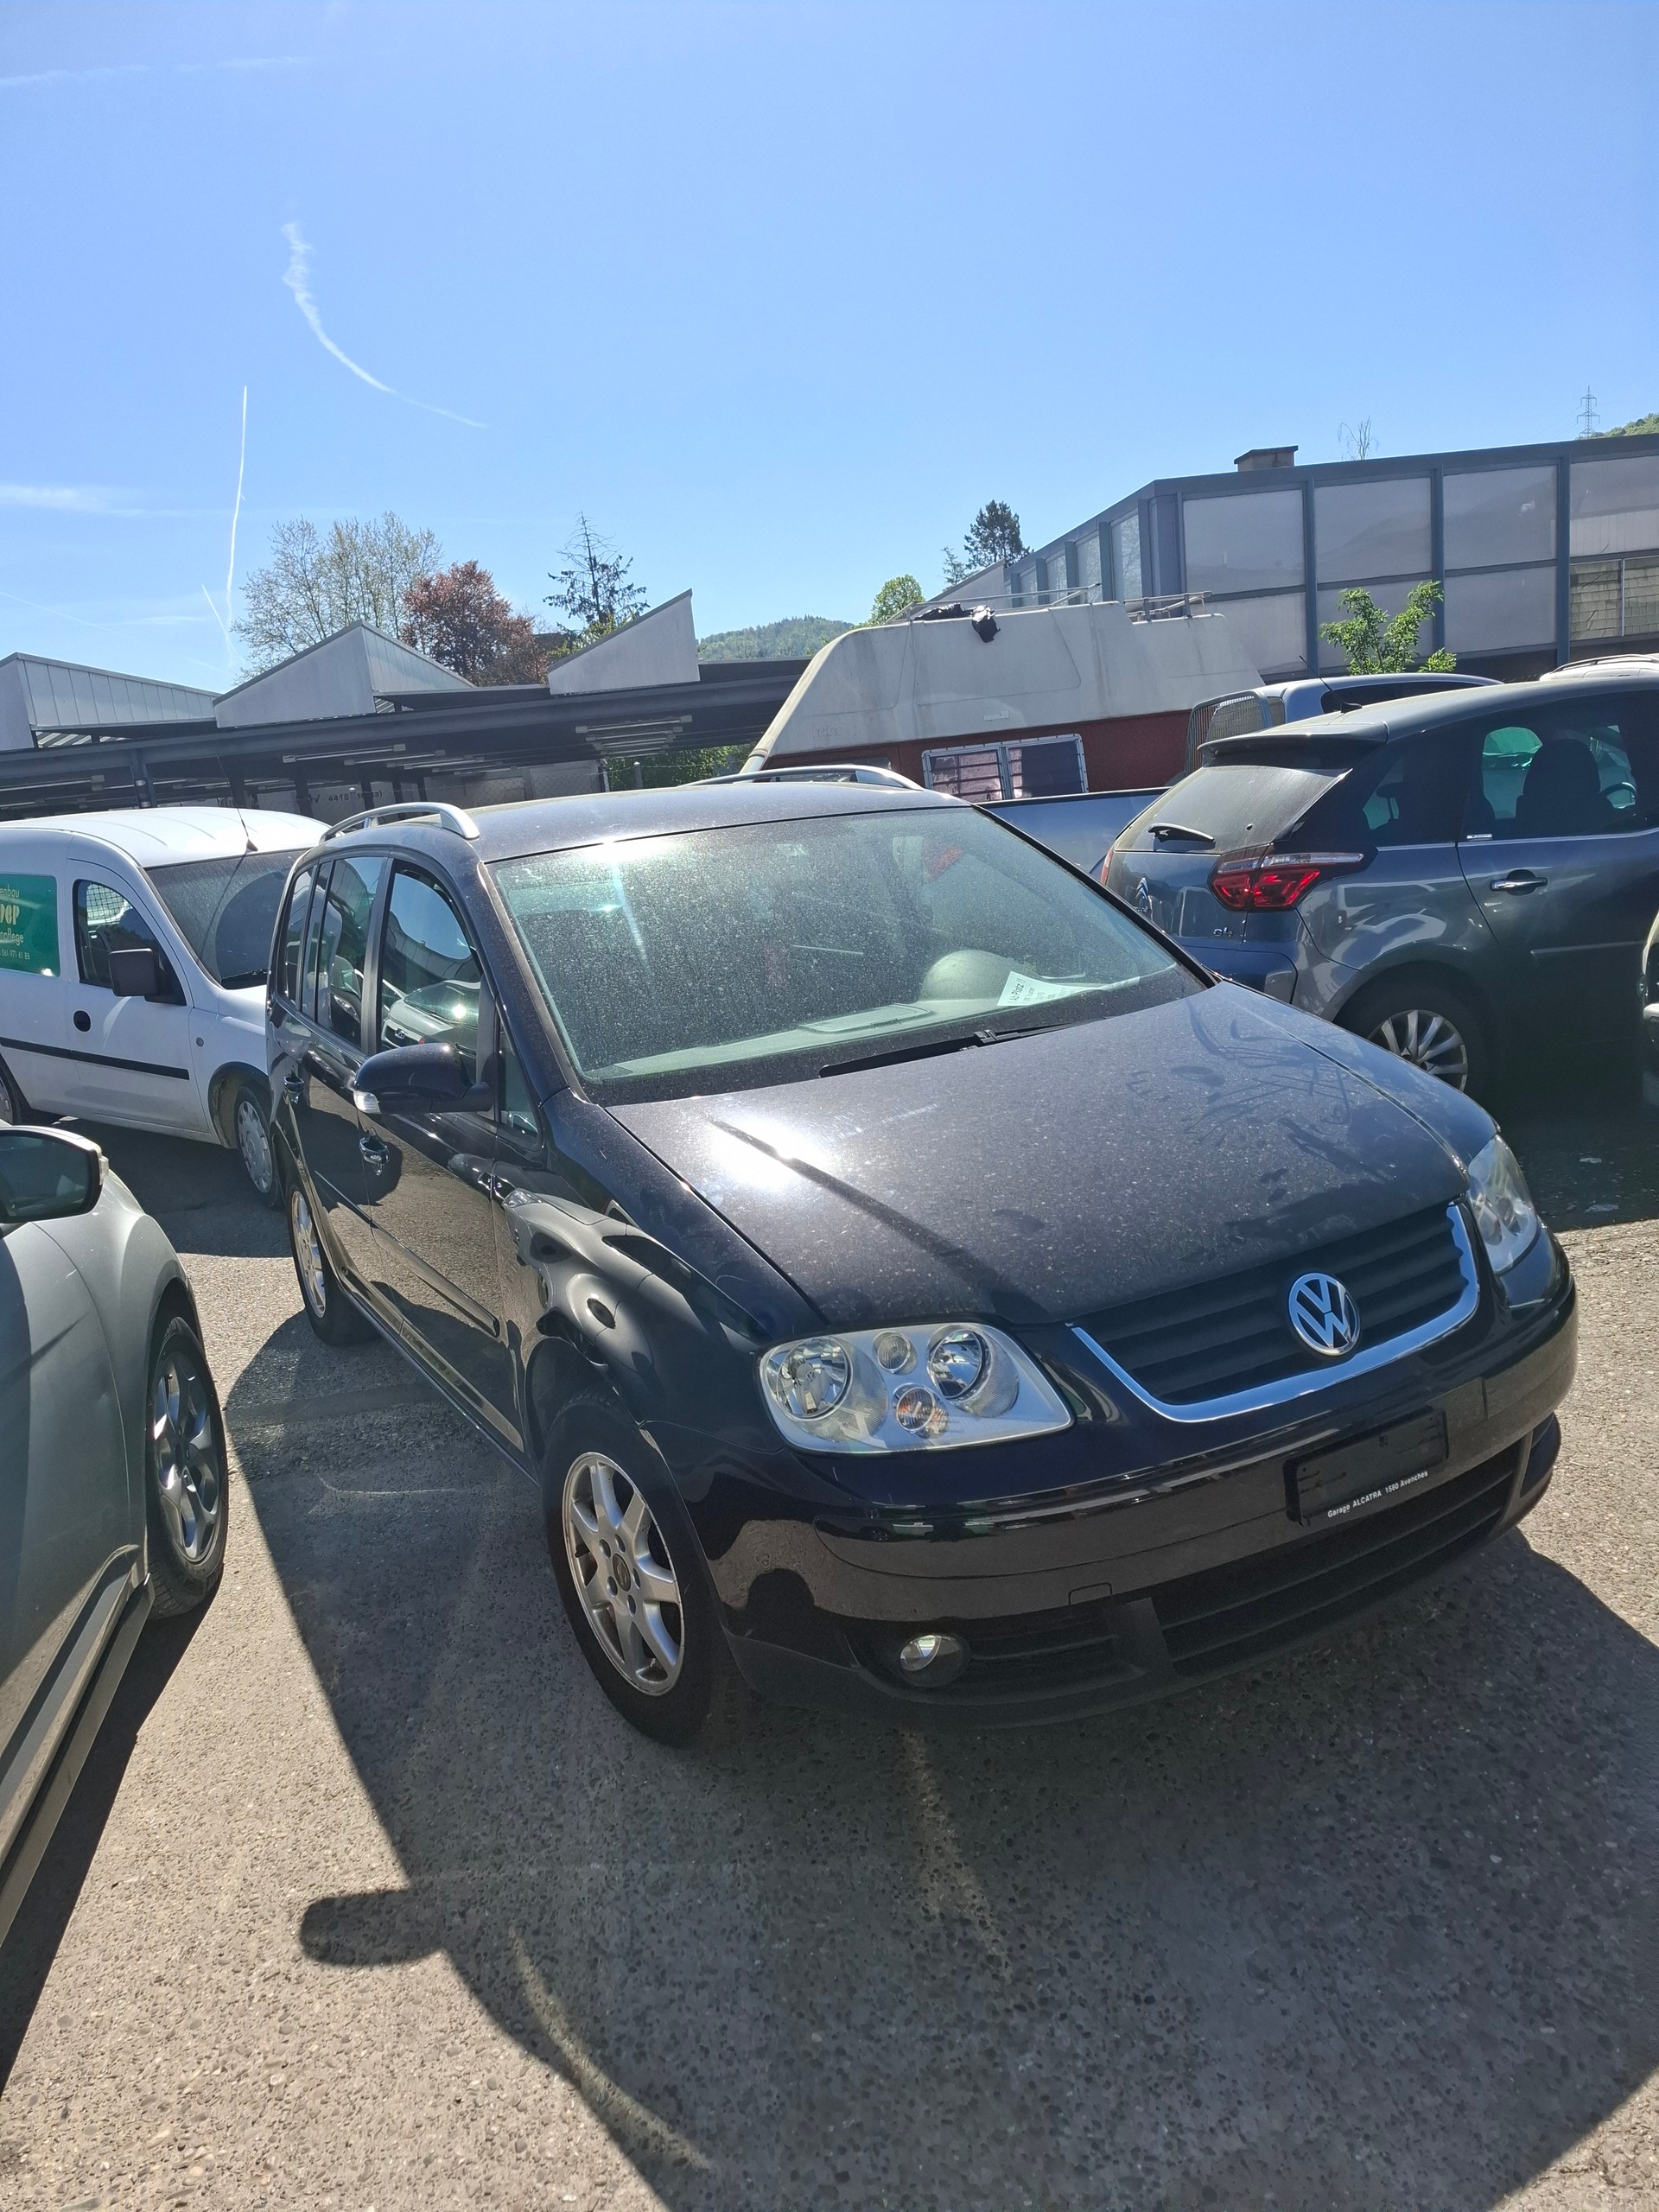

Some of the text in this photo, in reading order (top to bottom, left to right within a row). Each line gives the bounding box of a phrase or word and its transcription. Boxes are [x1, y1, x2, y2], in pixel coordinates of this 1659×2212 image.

[1290, 1274, 1359, 1354] VW
[1327, 1504, 1351, 1518] Garage
[1352, 1490, 1382, 1508] ALCATRA
[1400, 1471, 1428, 1488] Avenches
